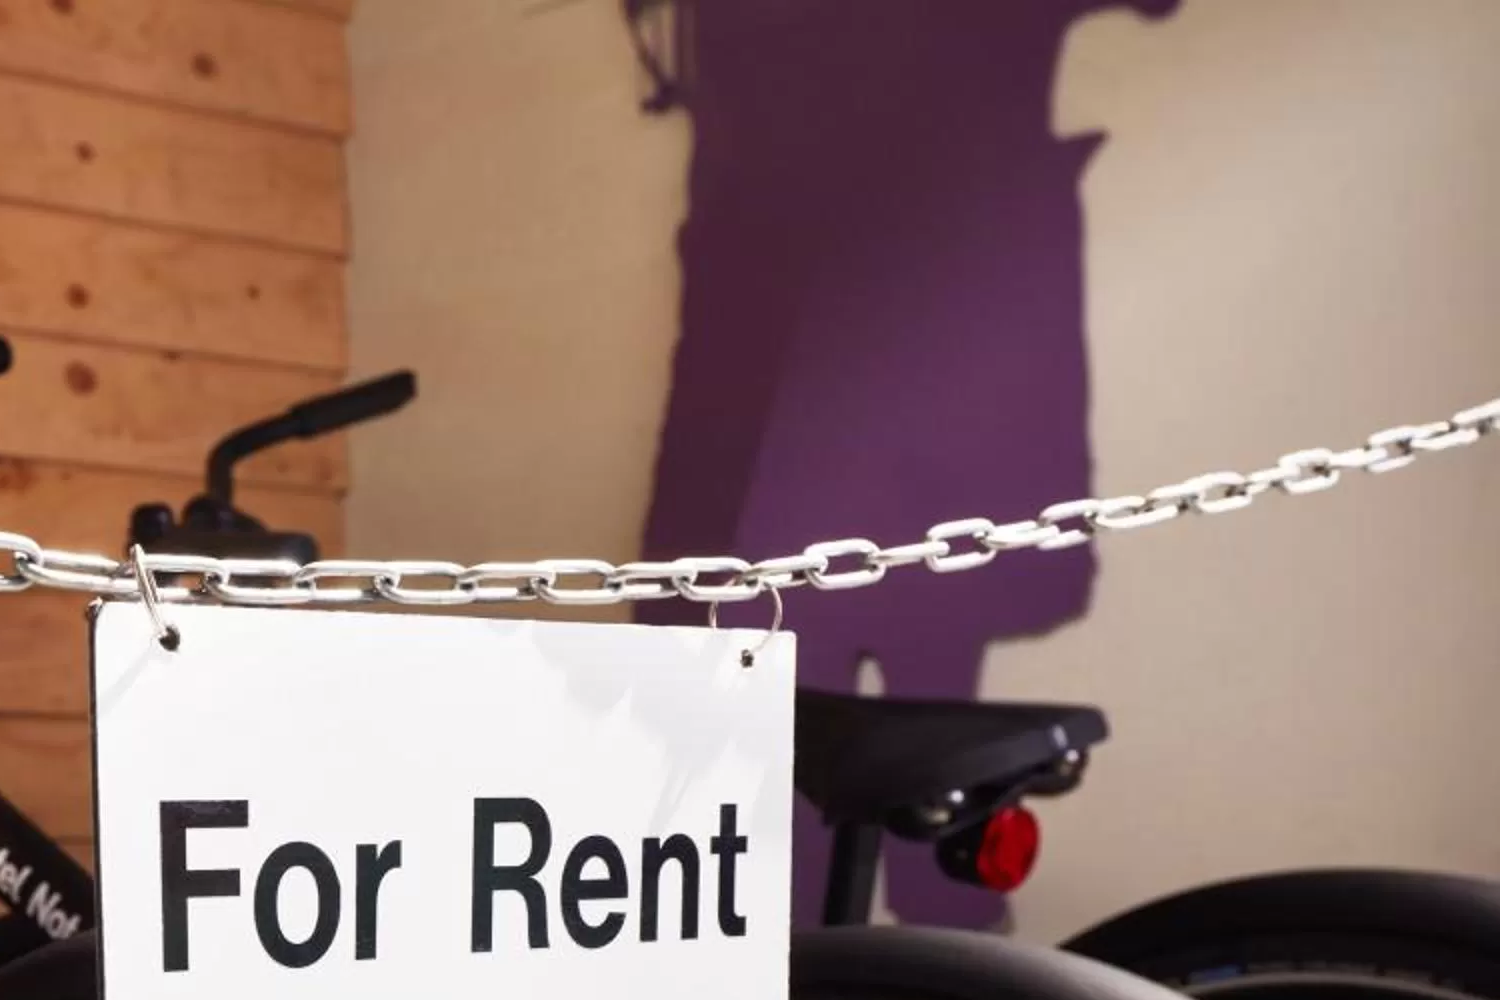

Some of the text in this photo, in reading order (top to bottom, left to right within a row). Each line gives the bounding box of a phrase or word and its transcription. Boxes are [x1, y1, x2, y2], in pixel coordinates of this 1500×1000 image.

[25, 880, 82, 940] Not
[159, 797, 748, 972] For Rent
